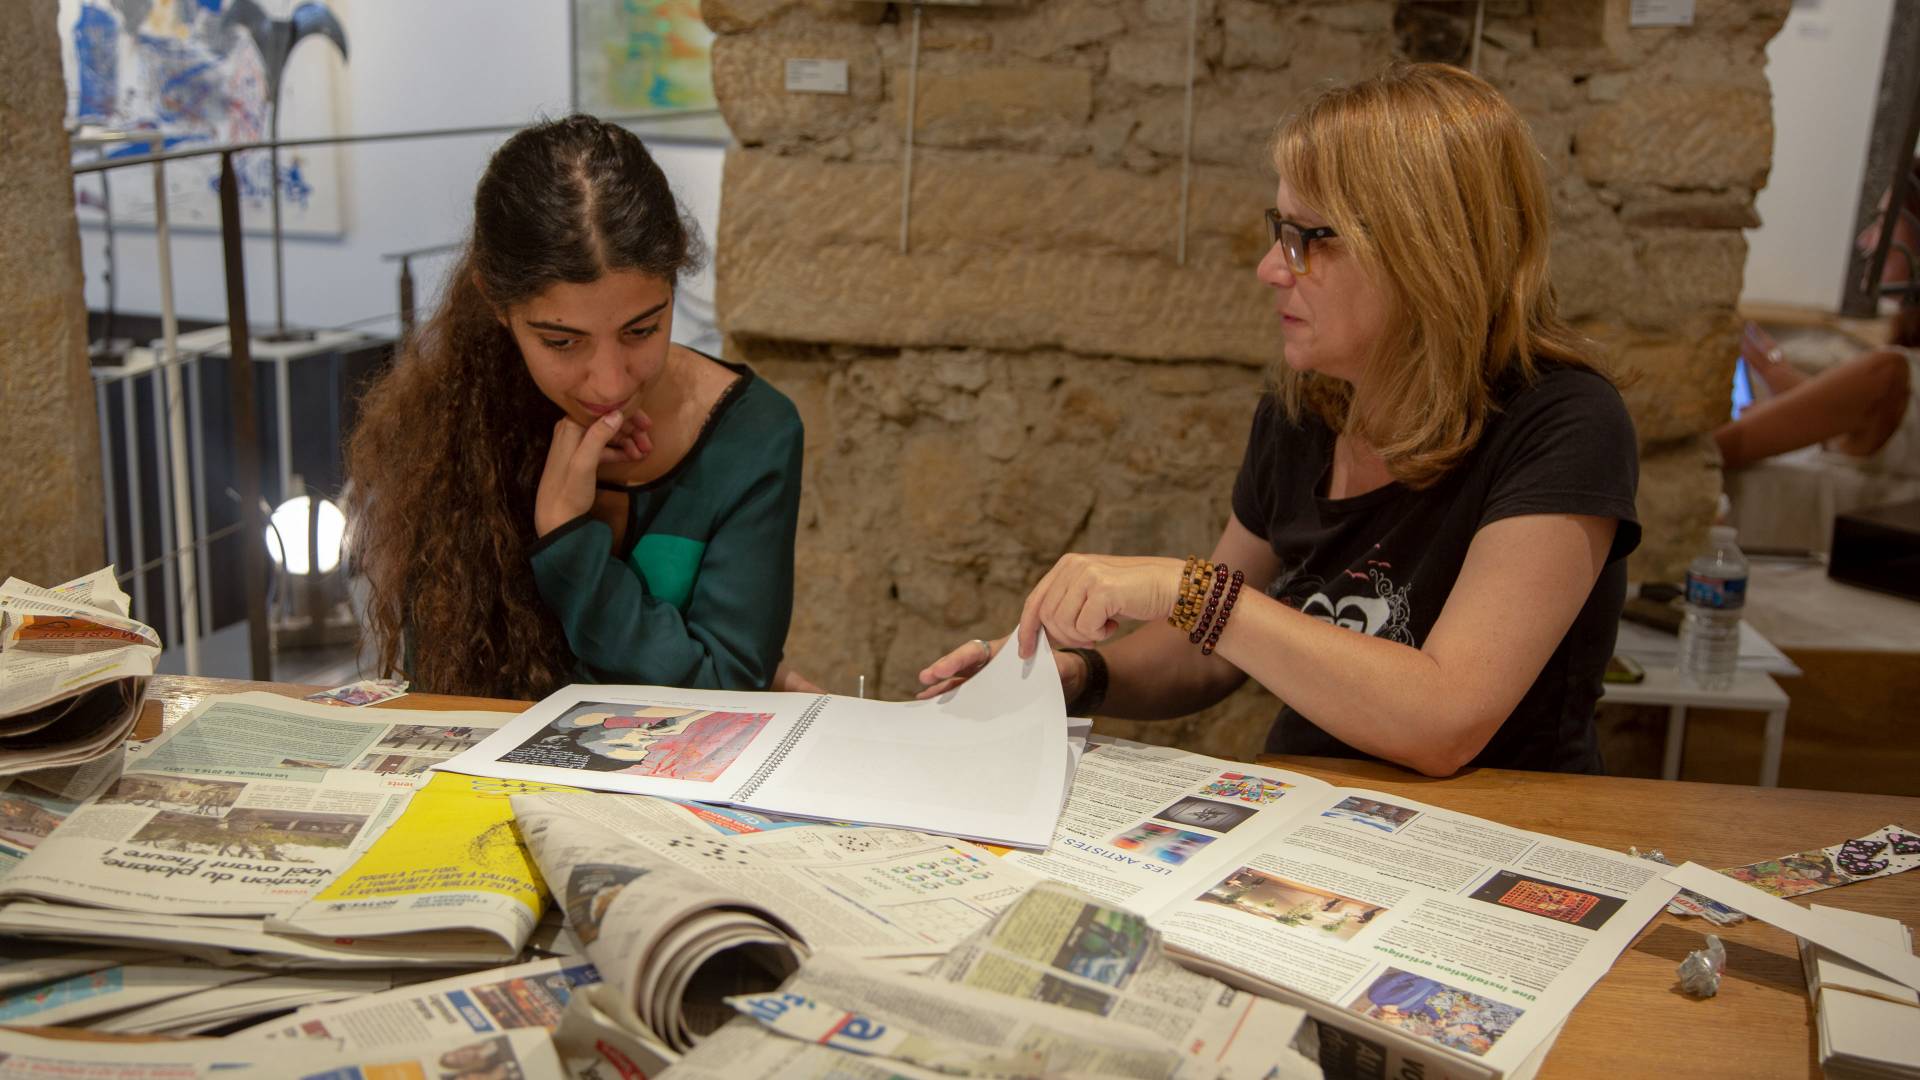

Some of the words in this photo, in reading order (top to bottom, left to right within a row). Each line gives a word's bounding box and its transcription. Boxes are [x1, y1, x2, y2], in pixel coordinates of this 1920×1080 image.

[1063, 838, 1140, 865] ARTISTES
[123, 849, 205, 869] l'heure
[210, 860, 280, 873] avant
[1142, 863, 1172, 876] LES
[201, 871, 234, 884] du
[240, 876, 322, 888] ination
[1373, 944, 1433, 967] artistique
[1436, 964, 1508, 993] installation
[1511, 989, 1537, 1002] Une
